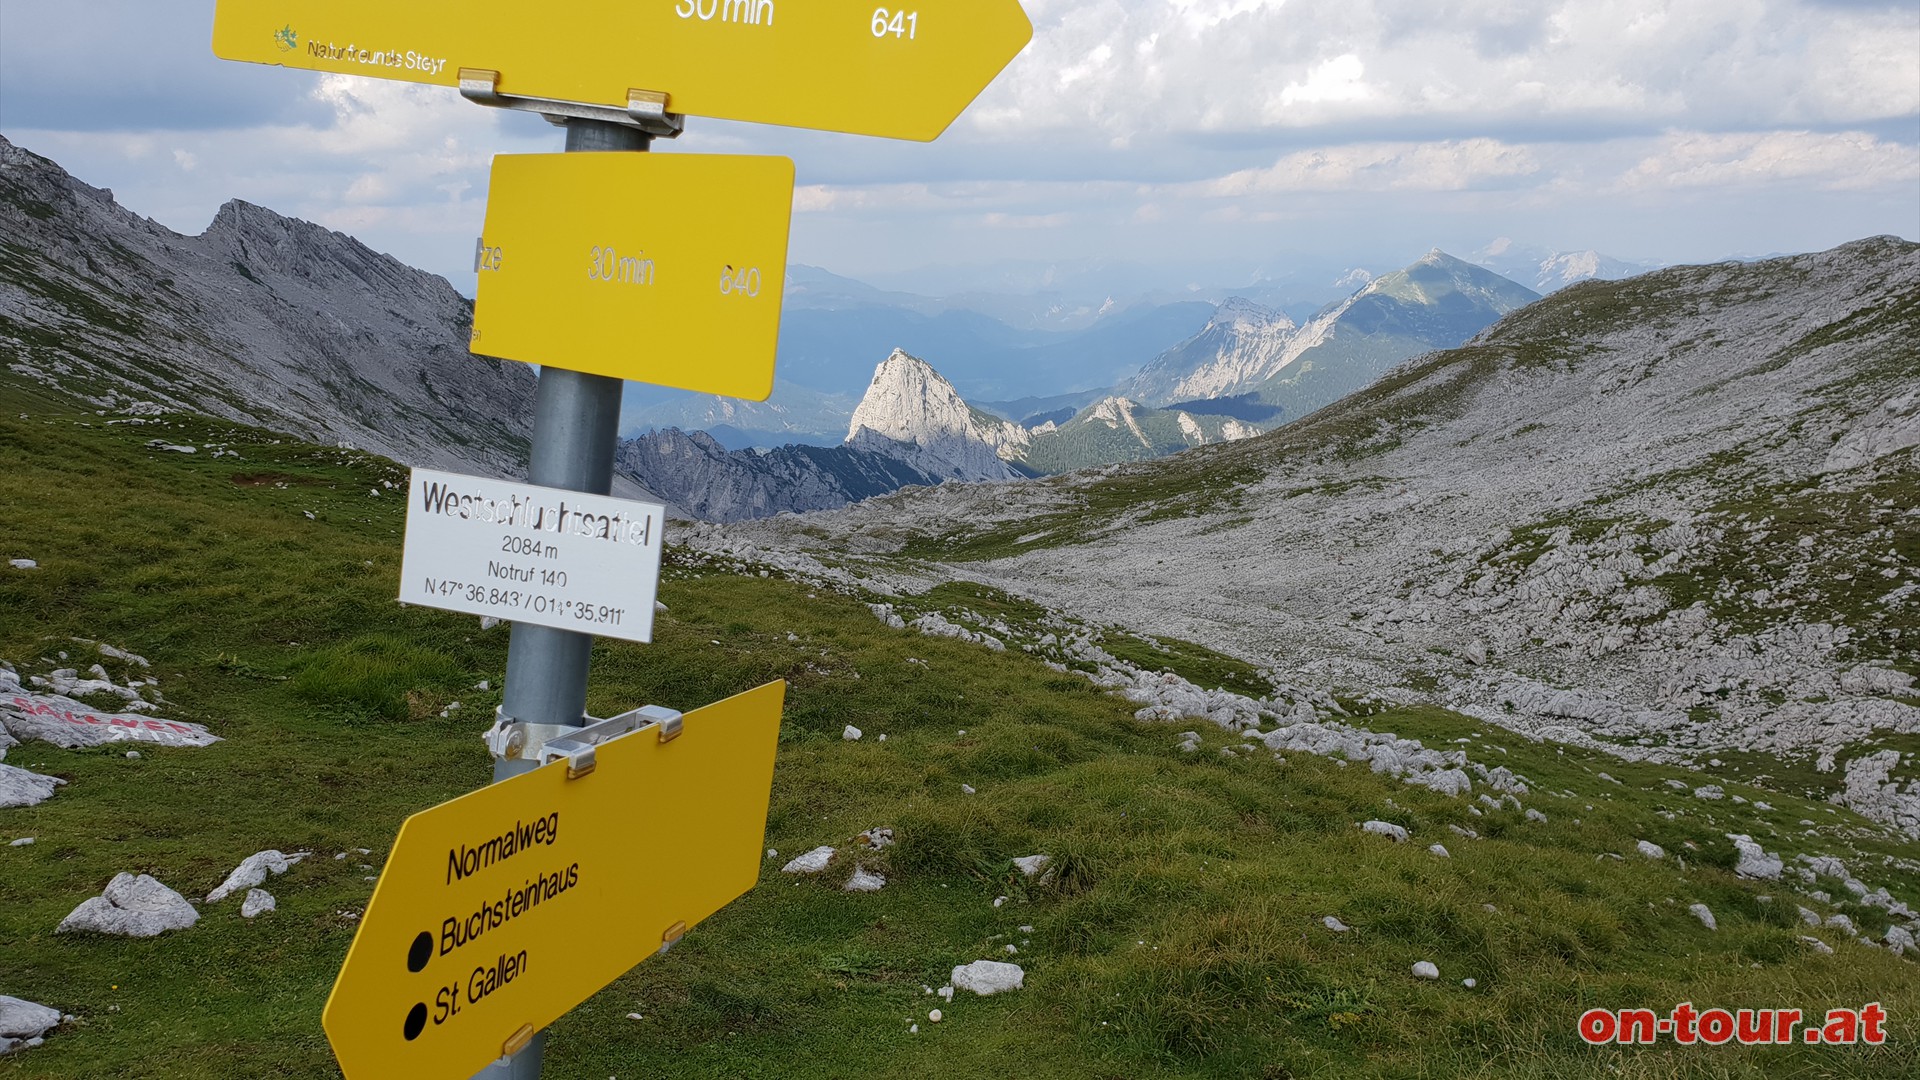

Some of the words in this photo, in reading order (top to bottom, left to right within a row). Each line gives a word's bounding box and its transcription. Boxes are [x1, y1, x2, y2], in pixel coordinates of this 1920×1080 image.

[722, 0, 774, 26] min
[870, 8, 919, 39] 641
[307, 39, 402, 68] Naturfreunde
[405, 51, 447, 75] Steyr
[587, 245, 617, 282] 30
[617, 249, 655, 286] min
[719, 264, 761, 298] 640
[423, 480, 652, 547] Westschluchtsattel
[502, 535, 542, 557] 2084
[544, 545, 558, 560] m
[488, 561, 535, 583] Notruf
[540, 568, 567, 588] 140
[446, 811, 559, 886] Normalweg
[439, 862, 579, 957] Buchsteinhaus
[433, 981, 462, 1026] St.
[467, 949, 528, 1005] Gallen
